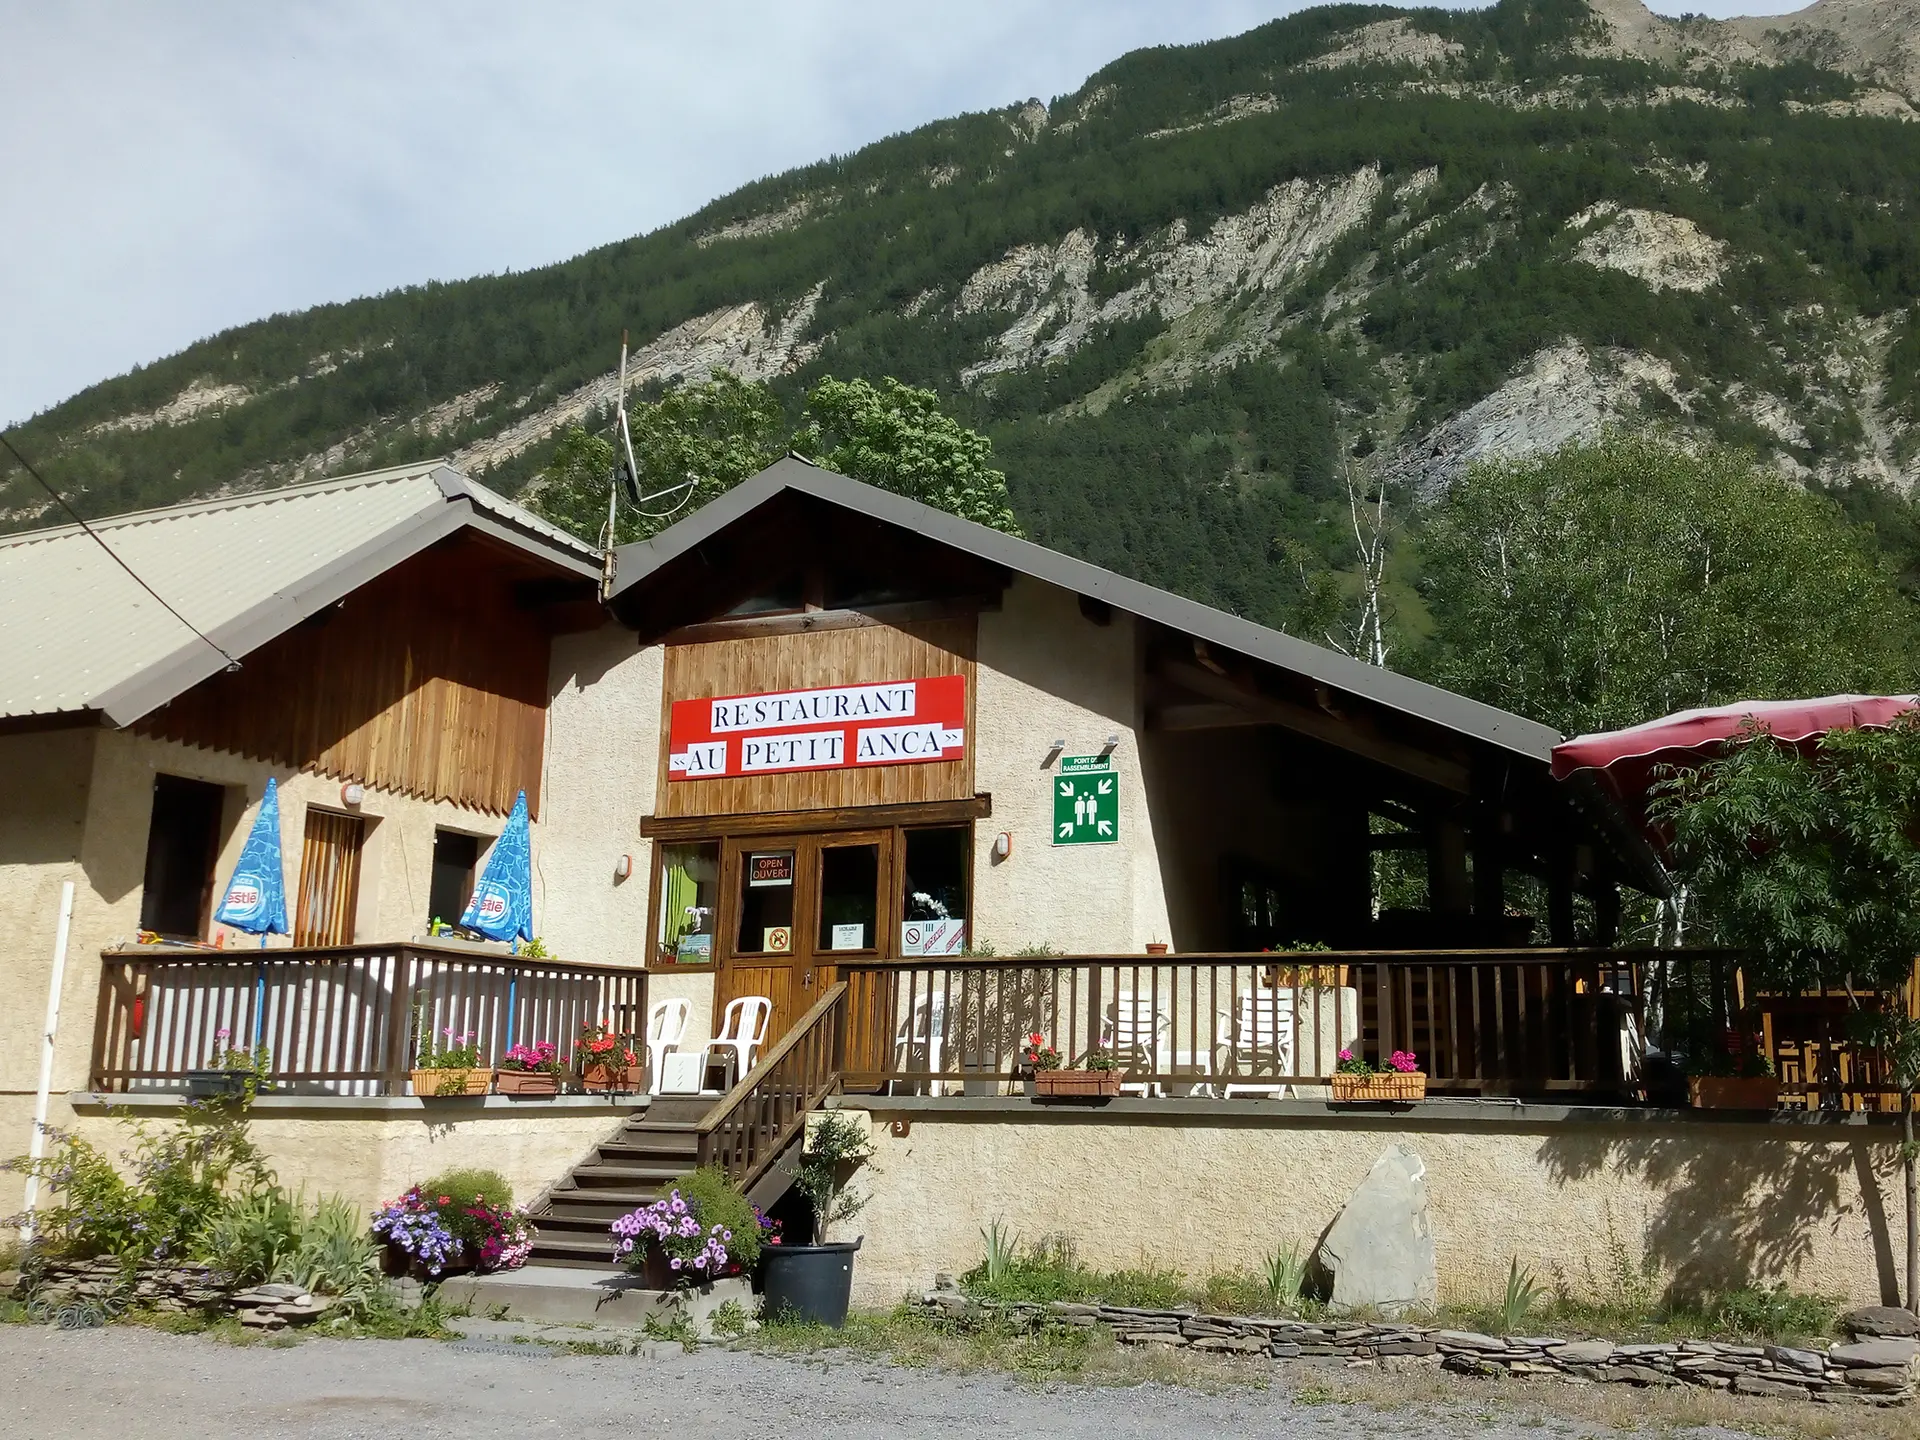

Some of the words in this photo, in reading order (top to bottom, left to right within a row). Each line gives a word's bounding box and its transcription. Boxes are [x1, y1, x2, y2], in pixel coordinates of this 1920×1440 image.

[714, 688, 914, 728] RESTAURANT
[744, 736, 843, 766] PETIT
[1063, 763, 1109, 771] RASSEMBLEMENT
[759, 859, 783, 868] OPEN
[753, 869, 789, 879] OUVERT
[227, 891, 257, 904] estlé
[896, 1121, 903, 1132] 3
